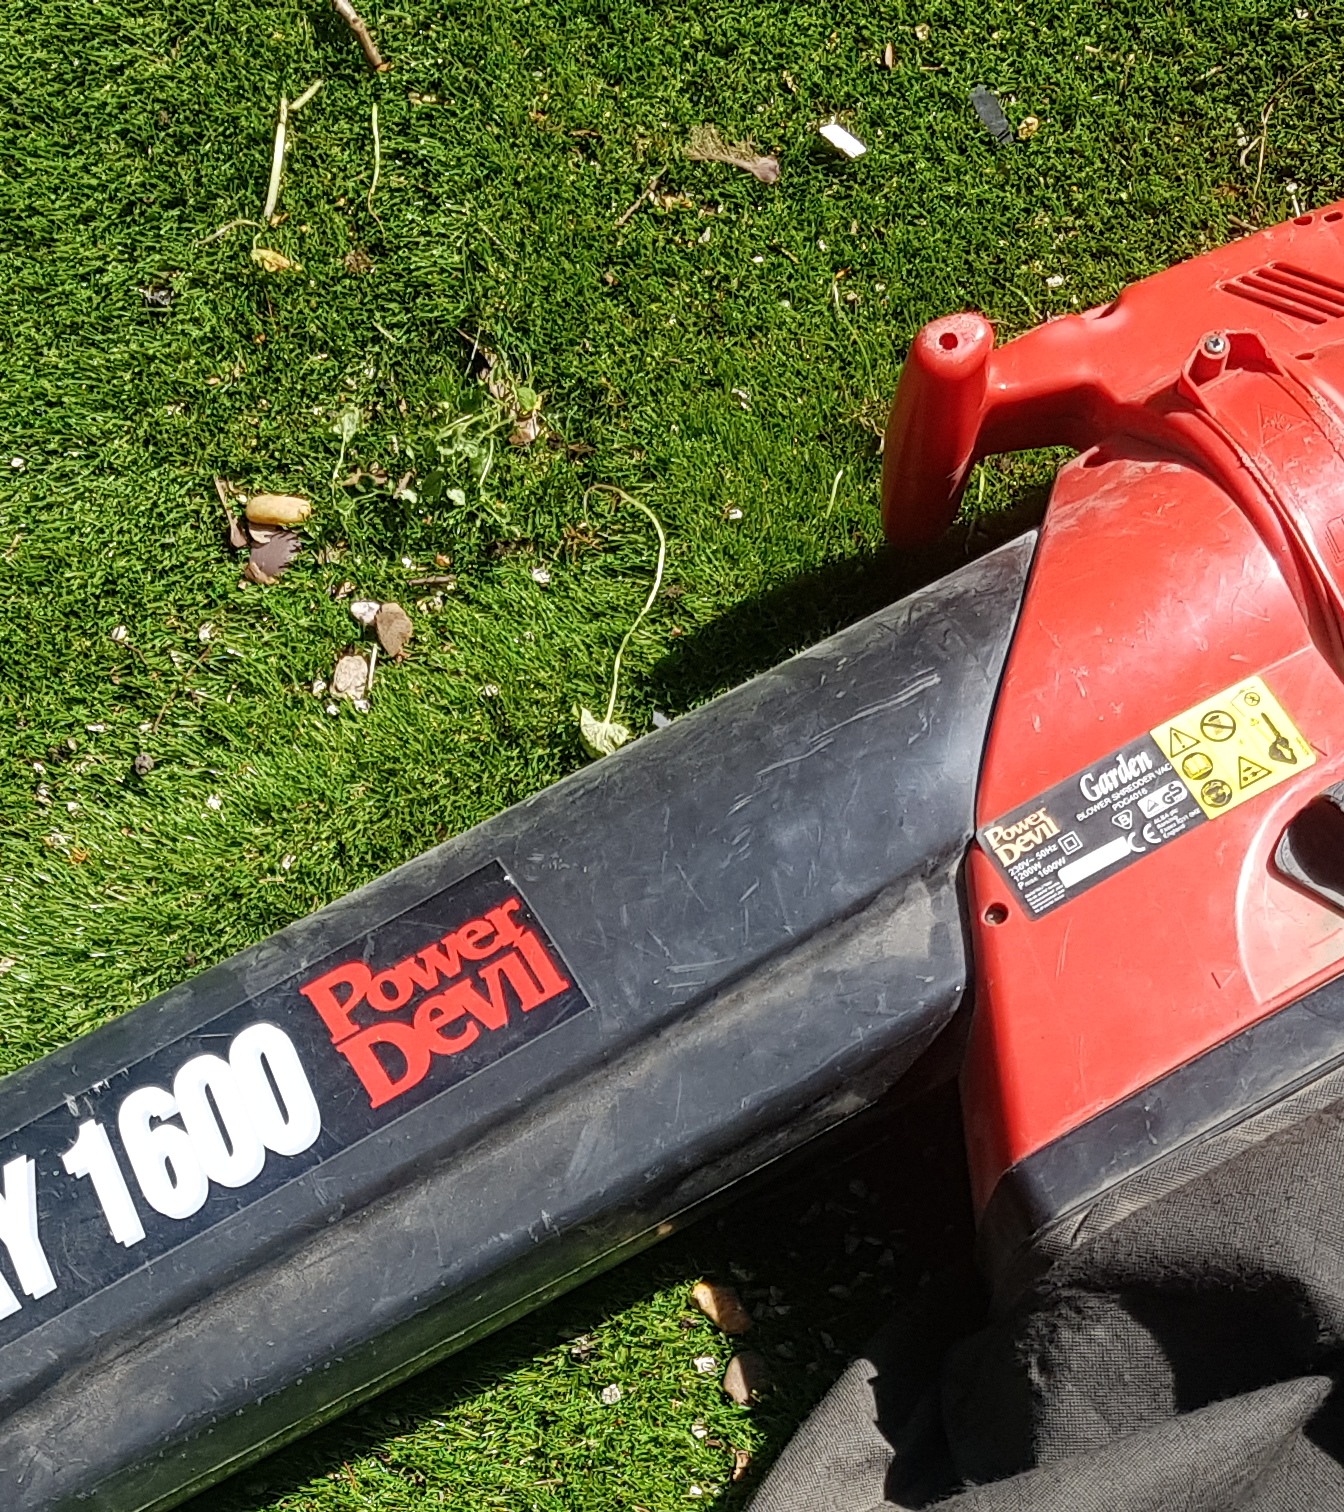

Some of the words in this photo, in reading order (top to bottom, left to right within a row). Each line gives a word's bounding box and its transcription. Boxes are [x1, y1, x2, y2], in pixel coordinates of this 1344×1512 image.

[1076, 797, 1110, 822] BLOWER
[1111, 772, 1156, 801] SHREDDER
[1155, 763, 1173, 776] VAC
[1080, 751, 1153, 801] Garden
[984, 807, 1048, 850] Power
[994, 817, 1062, 867] Devil
[1035, 843, 1059, 861] 50Hz
[1013, 861, 1042, 883] 1200W
[1038, 857, 1067, 878] 1600W
[300, 897, 525, 1043] Power
[334, 926, 571, 1109] Devil
[61, 1023, 323, 1247] 1600
